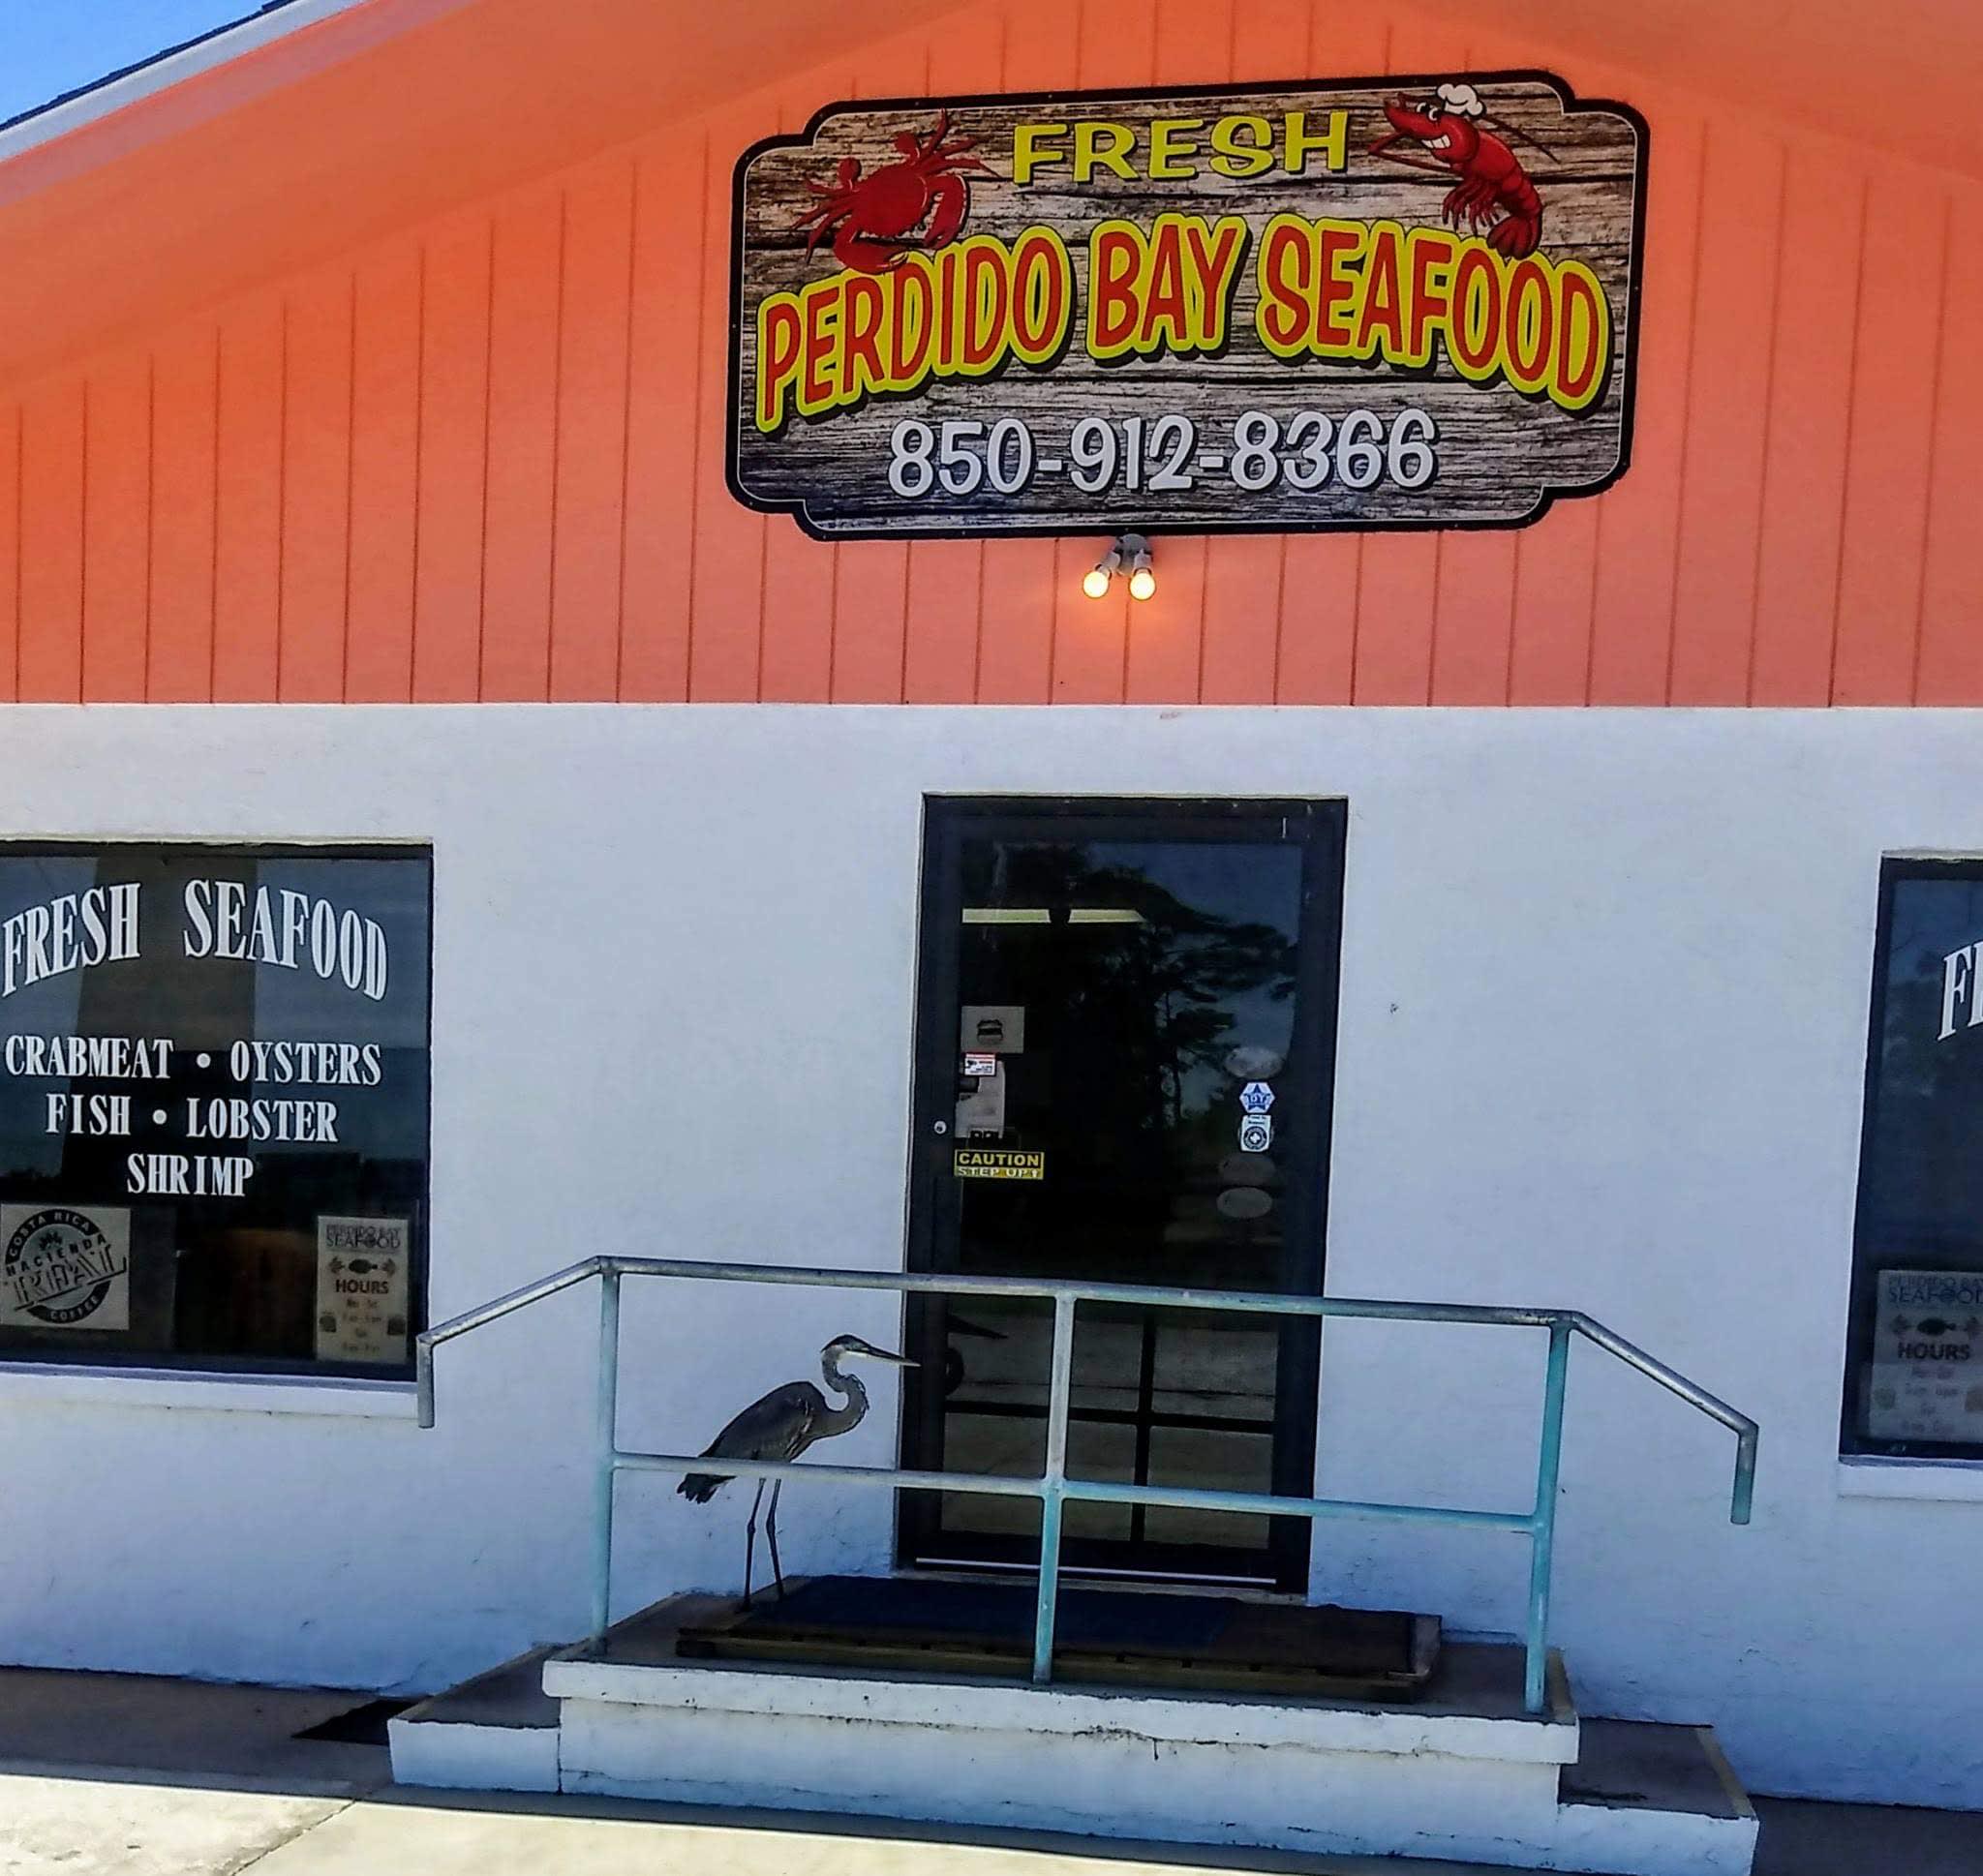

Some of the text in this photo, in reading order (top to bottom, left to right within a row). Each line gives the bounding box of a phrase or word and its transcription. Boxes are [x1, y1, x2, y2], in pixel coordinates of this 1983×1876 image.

[1012, 109, 1350, 186] FRESH
[754, 213, 1612, 434] PERDIDO BAY SEAFOOD
[888, 408, 1438, 499] 850-912-8366
[1, 879, 387, 1001] FRESH SEAFOOD
[5, 1035, 382, 1085] CRABMEAT OYSTERS
[46, 1093, 339, 1141] FISH LOBSTER
[127, 1153, 255, 1196] SHRIMP
[958, 1152, 1040, 1167] CAUTION
[6, 1233, 107, 1277] HACIENDA
[9, 1211, 91, 1256] COSTA RICA
[49, 1295, 101, 1320] COFFEE
[335, 1279, 389, 1294] HOURS
[1897, 1342, 1971, 1361] HOURS
